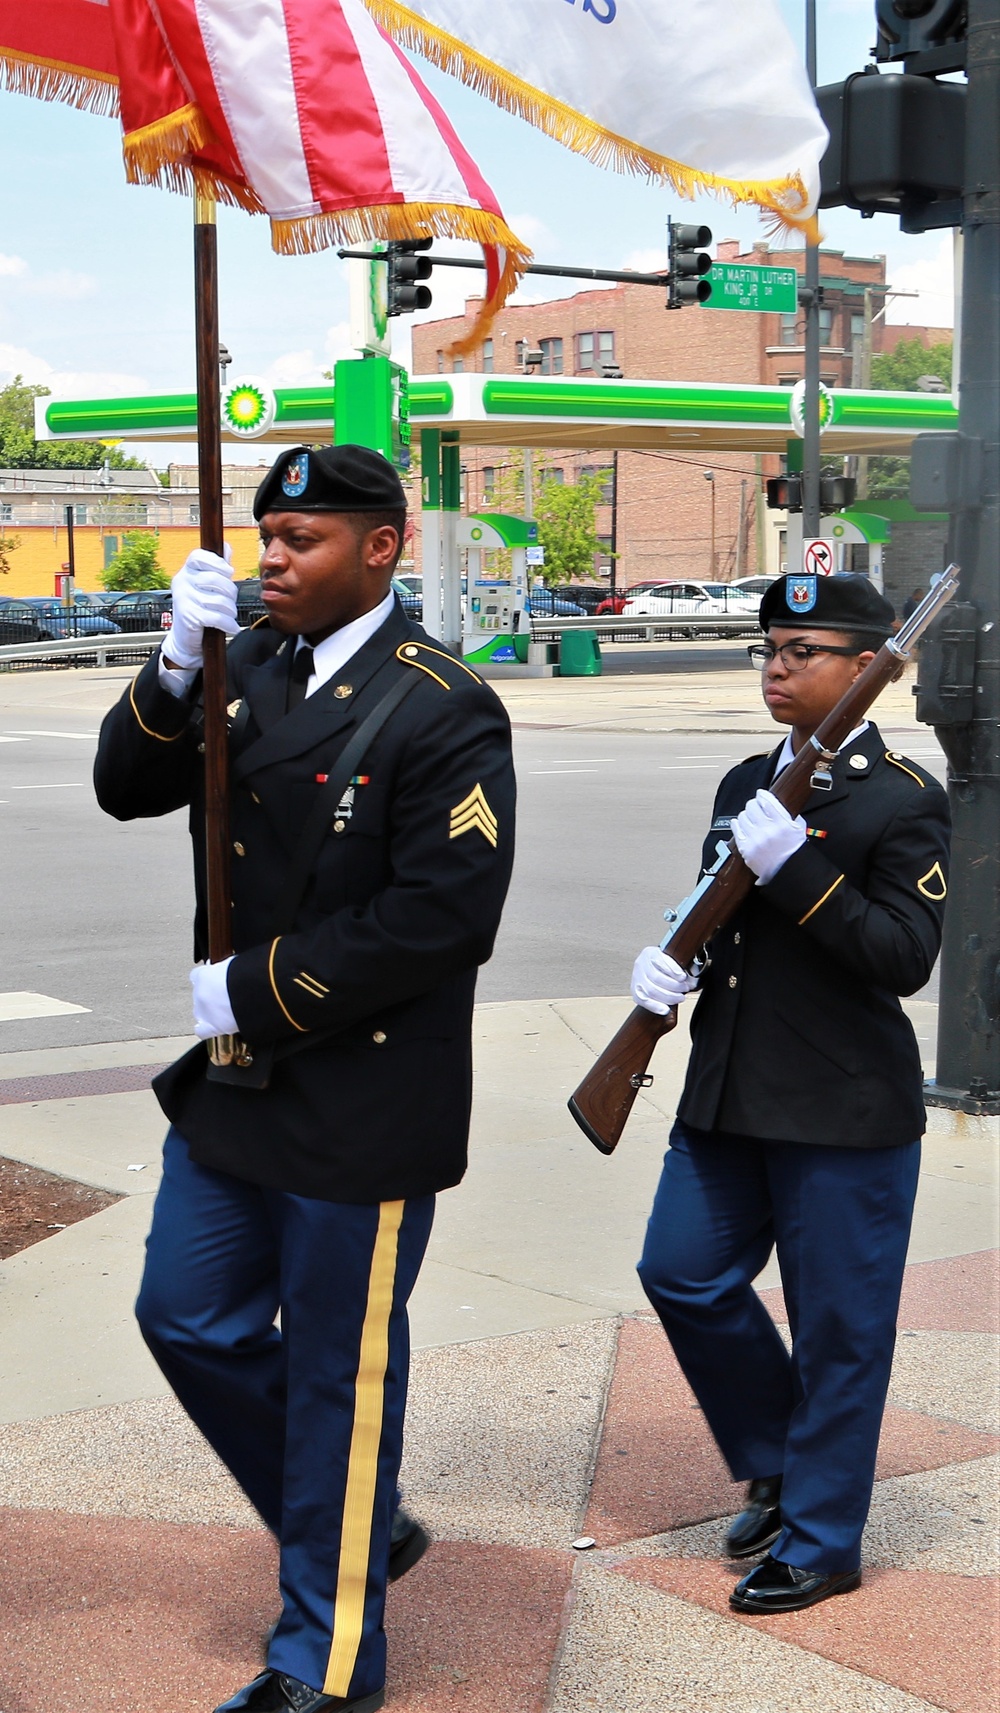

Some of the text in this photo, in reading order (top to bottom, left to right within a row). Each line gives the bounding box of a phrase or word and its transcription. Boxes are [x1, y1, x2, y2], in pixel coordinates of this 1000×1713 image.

[711, 267, 794, 286] DR MARTIN LUTHER
[724, 282, 773, 297] KING JR DR
[754, 297, 759, 307] E
